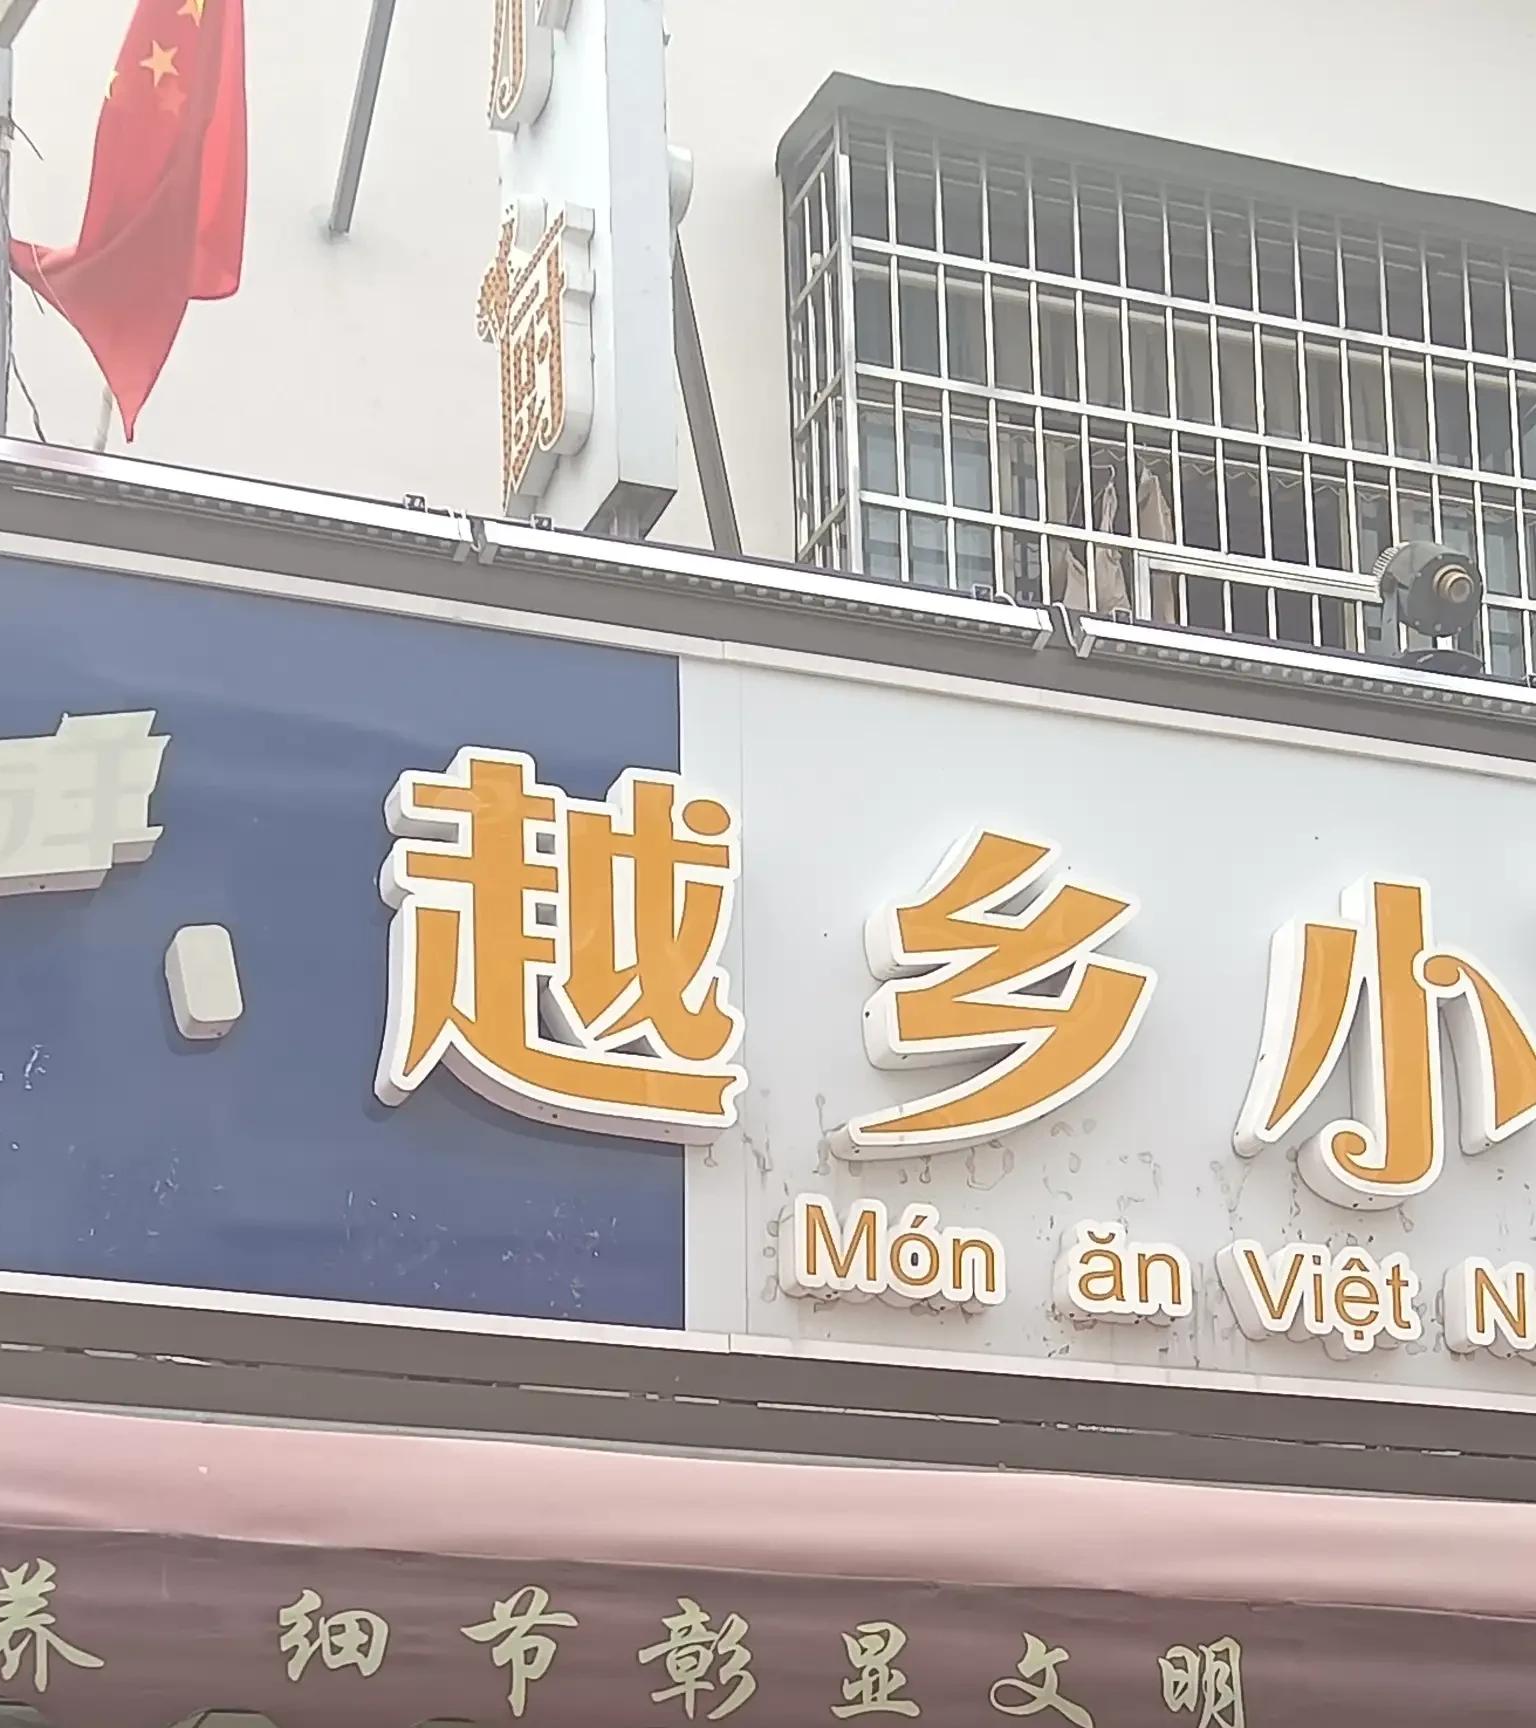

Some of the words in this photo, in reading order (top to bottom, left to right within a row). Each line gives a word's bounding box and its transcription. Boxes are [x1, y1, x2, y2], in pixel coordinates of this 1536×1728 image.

[800, 1200, 1004, 1300] Món
[1072, 1227, 1192, 1314] ăn
[1234, 1242, 1419, 1344] Việt
